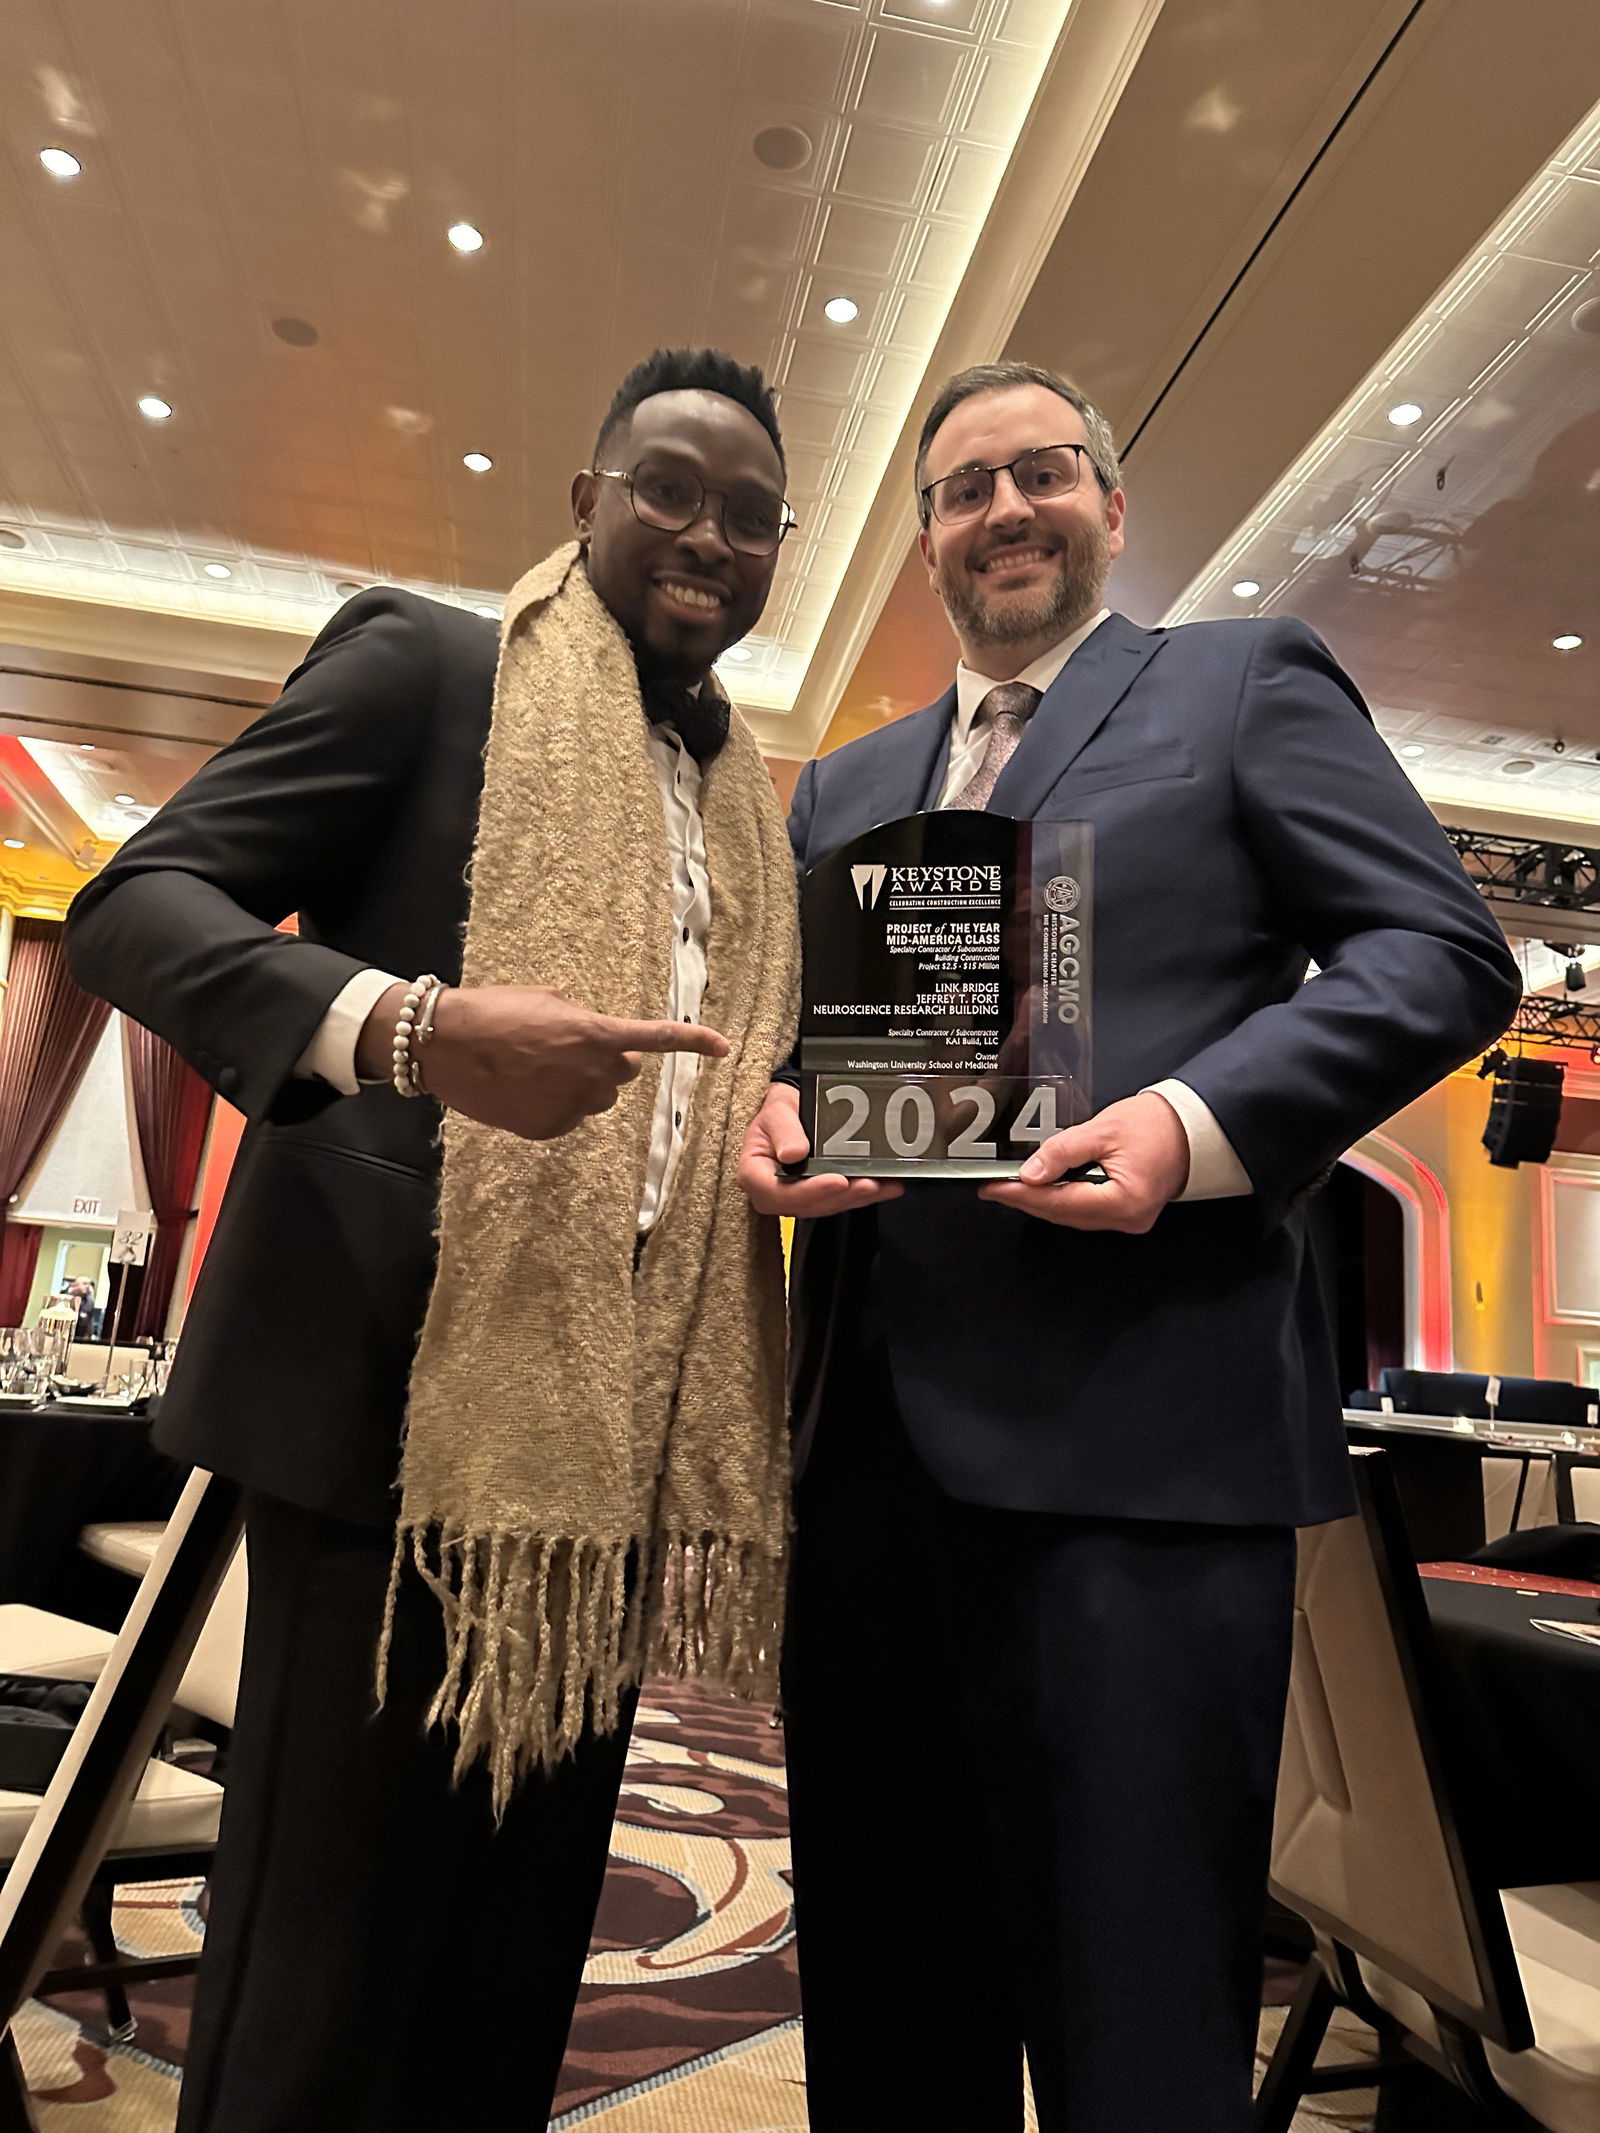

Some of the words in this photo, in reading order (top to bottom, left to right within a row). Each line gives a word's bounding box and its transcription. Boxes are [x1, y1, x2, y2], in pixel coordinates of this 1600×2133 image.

[891, 866, 1001, 881] KEYSTONE
[891, 880, 1001, 892] AWARDS
[886, 924, 932, 934] PROJECT
[934, 923, 948, 935] of
[950, 923, 970, 933] THE
[973, 923, 1000, 933] YEAR
[886, 935, 962, 945] MID-AMERICA
[965, 935, 1000, 945] CLASS
[889, 946, 917, 954] Specialty
[957, 945, 1000, 953] Subcontractor
[934, 954, 959, 962] Building
[918, 963, 940, 971] Project
[941, 962, 957, 970] $2.5
[963, 962, 977, 970] $15
[978, 962, 1000, 970] Million
[1050, 951, 1058, 987] CHAPTER
[1058, 914, 1080, 1024] AGCMO
[935, 983, 960, 993] LINK
[962, 983, 1000, 993] BRIDGE
[916, 994, 955, 1005] JEFFREY
[958, 994, 968, 1004] T.
[971, 994, 999, 1004] FORT
[813, 1005, 892, 1015] NEUROSCIENCE
[894, 1005, 946, 1015] RESEARCH
[949, 1005, 999, 1015] BUILDING
[888, 1029, 914, 1037] Specialty
[945, 1037, 960, 1045] KAI
[962, 1037, 982, 1046] Build,
[984, 1037, 999, 1045] LLC
[847, 1060, 889, 1070] Washington
[890, 1060, 926, 1070] University
[928, 1060, 953, 1069] School
[954, 1060, 963, 1069] of
[964, 1060, 999, 1069] Medicine
[822, 1084, 1064, 1158] 2024
[73, 1198, 100, 1214] EXIT
